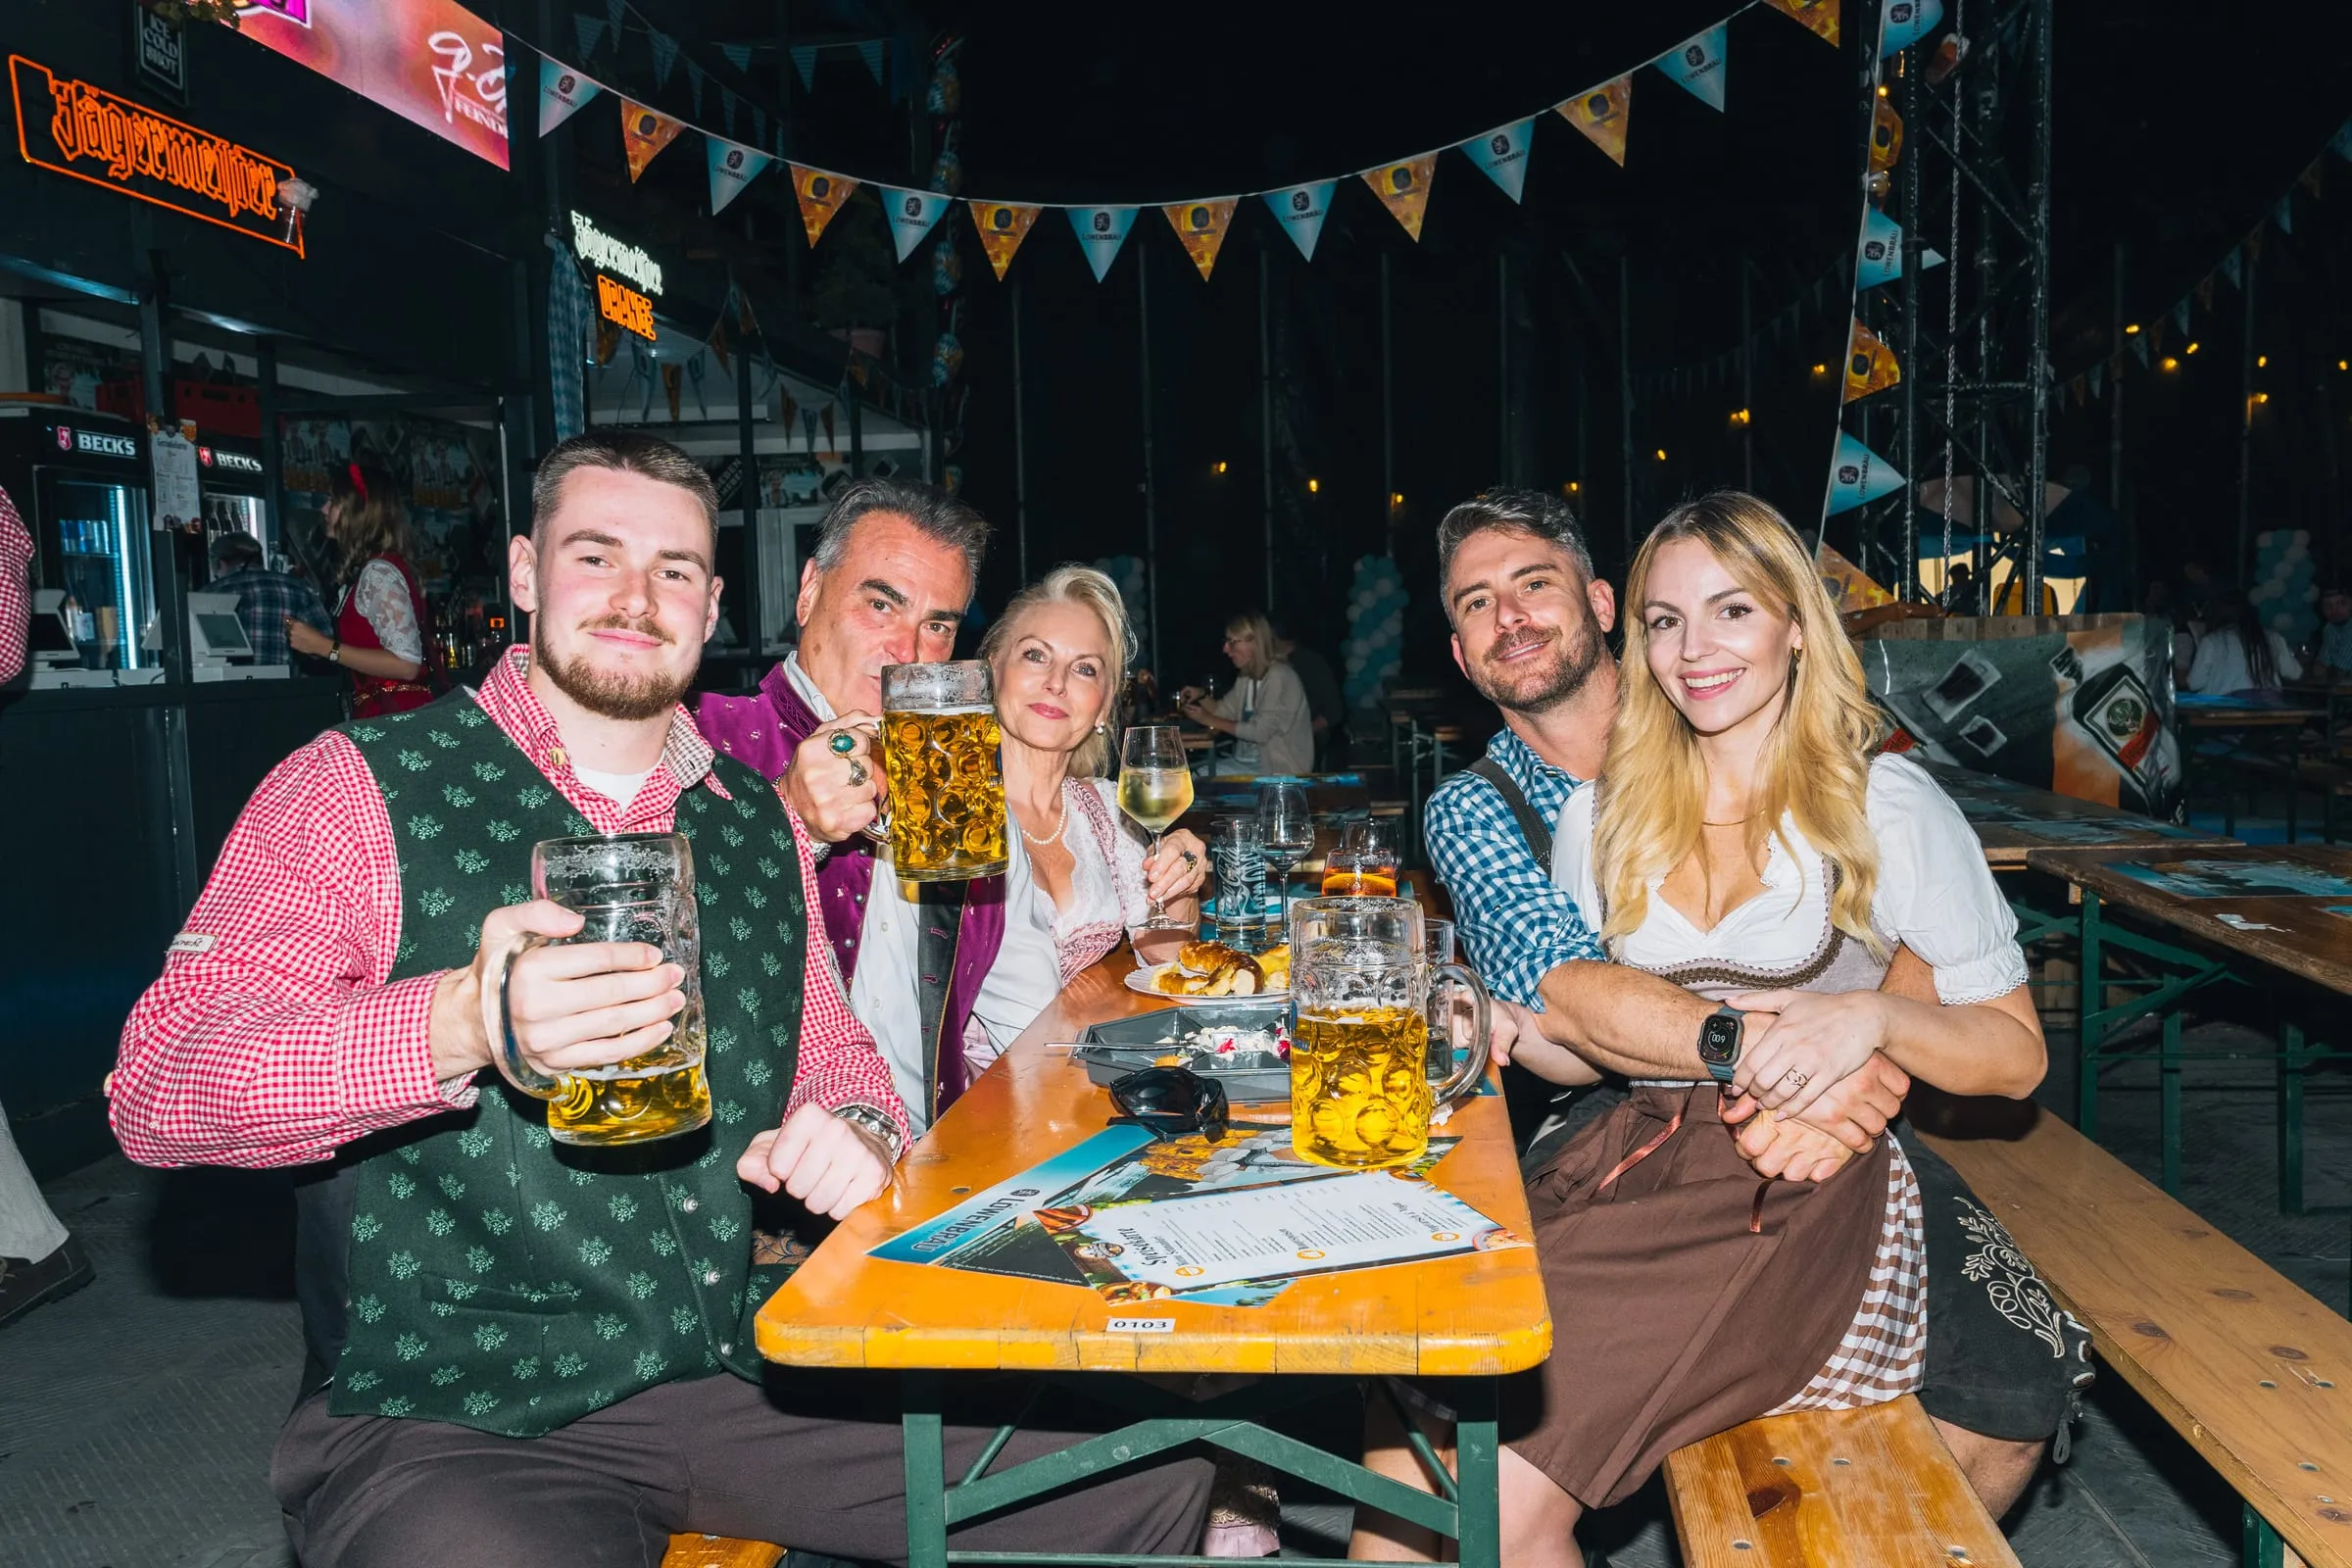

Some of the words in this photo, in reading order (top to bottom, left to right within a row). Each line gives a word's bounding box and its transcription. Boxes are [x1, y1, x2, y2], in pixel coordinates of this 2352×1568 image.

[144, 27, 178, 59] COLD
[145, 44, 177, 74] SHOT
[911, 1198, 1026, 1252] LÖWENBRÄU
[1117, 1227, 1167, 1266] Speisekarte
[1114, 1320, 1167, 1329] 0103
